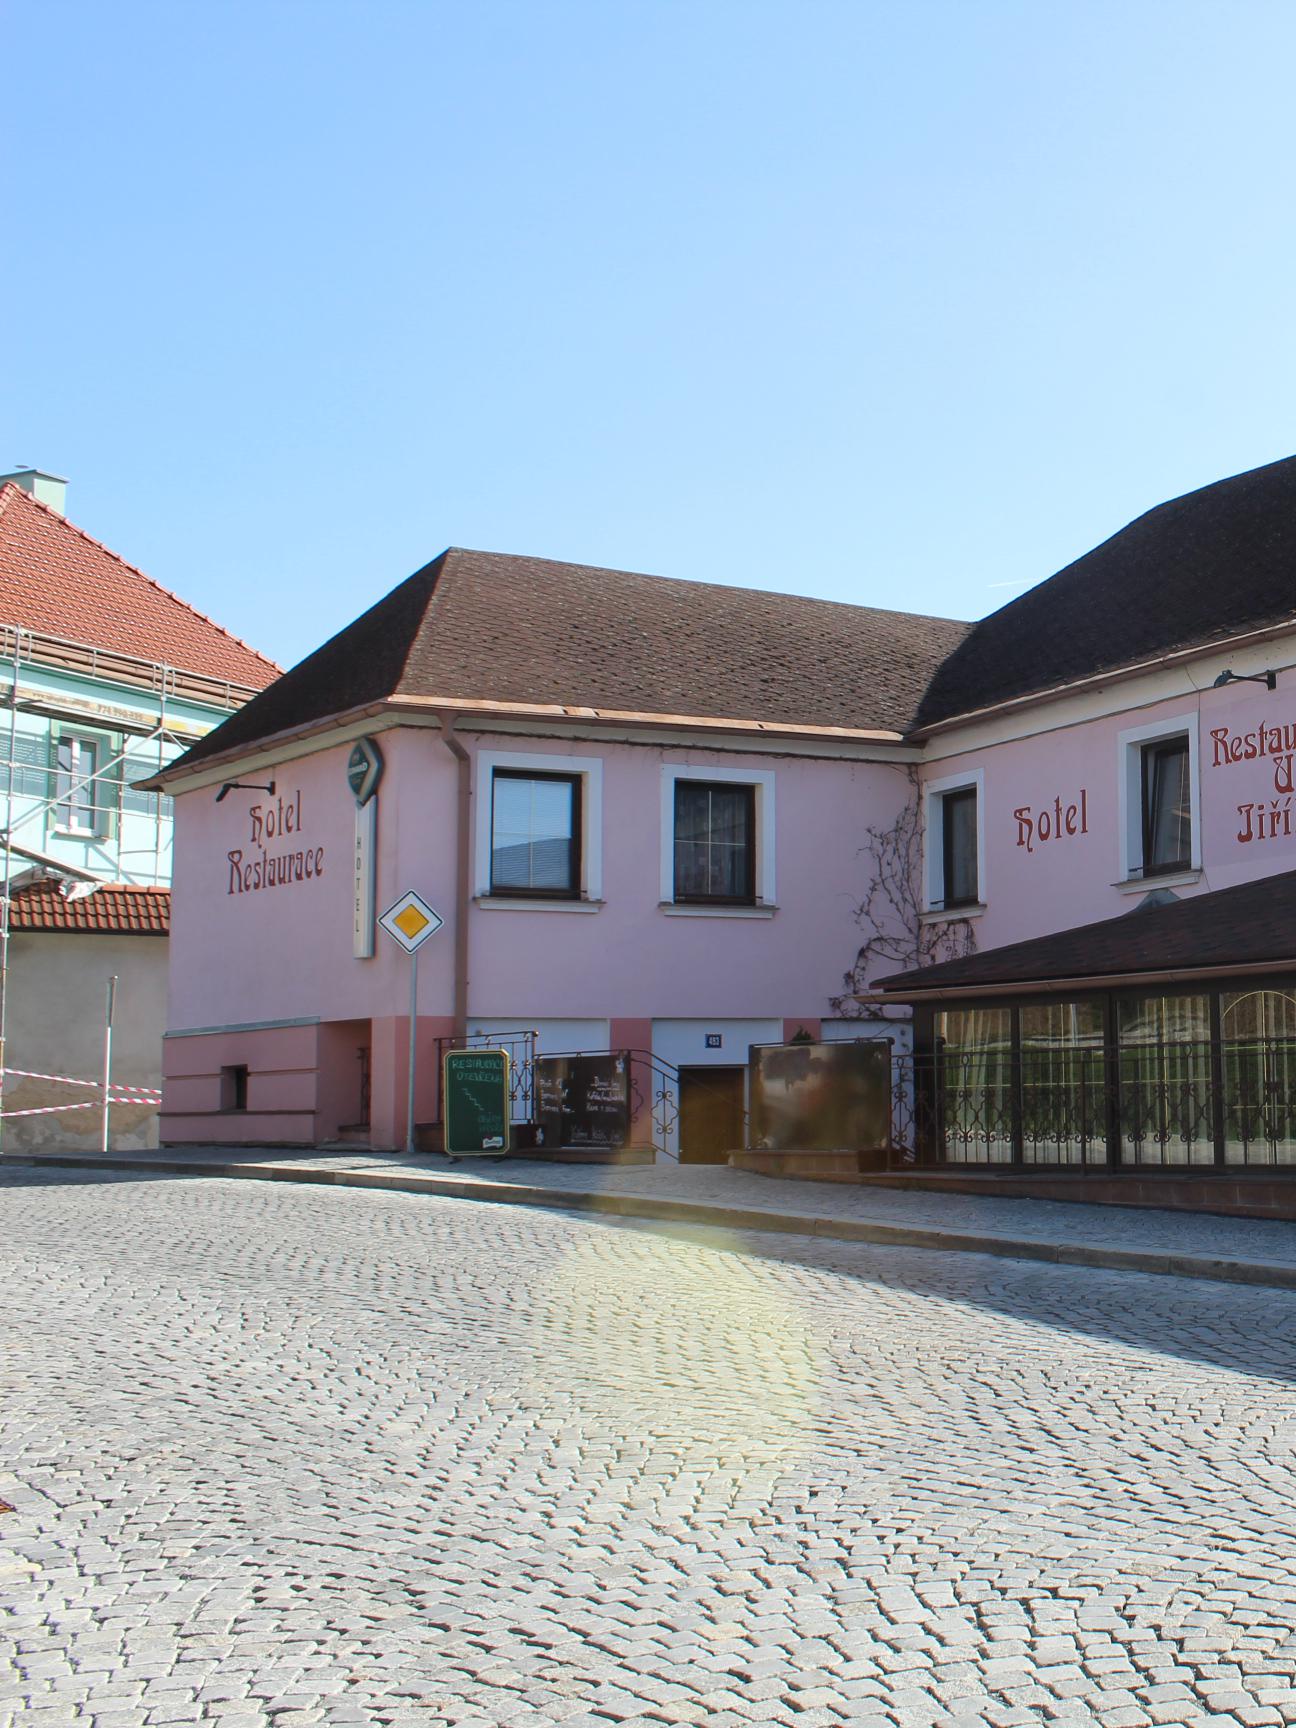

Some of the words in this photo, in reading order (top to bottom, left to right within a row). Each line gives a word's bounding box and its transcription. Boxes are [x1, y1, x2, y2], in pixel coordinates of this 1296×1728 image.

[1273, 754, 1295, 794] U
[250, 790, 302, 848] Hotel
[1014, 789, 1088, 853] Hotel
[227, 847, 324, 895] Restaurace
